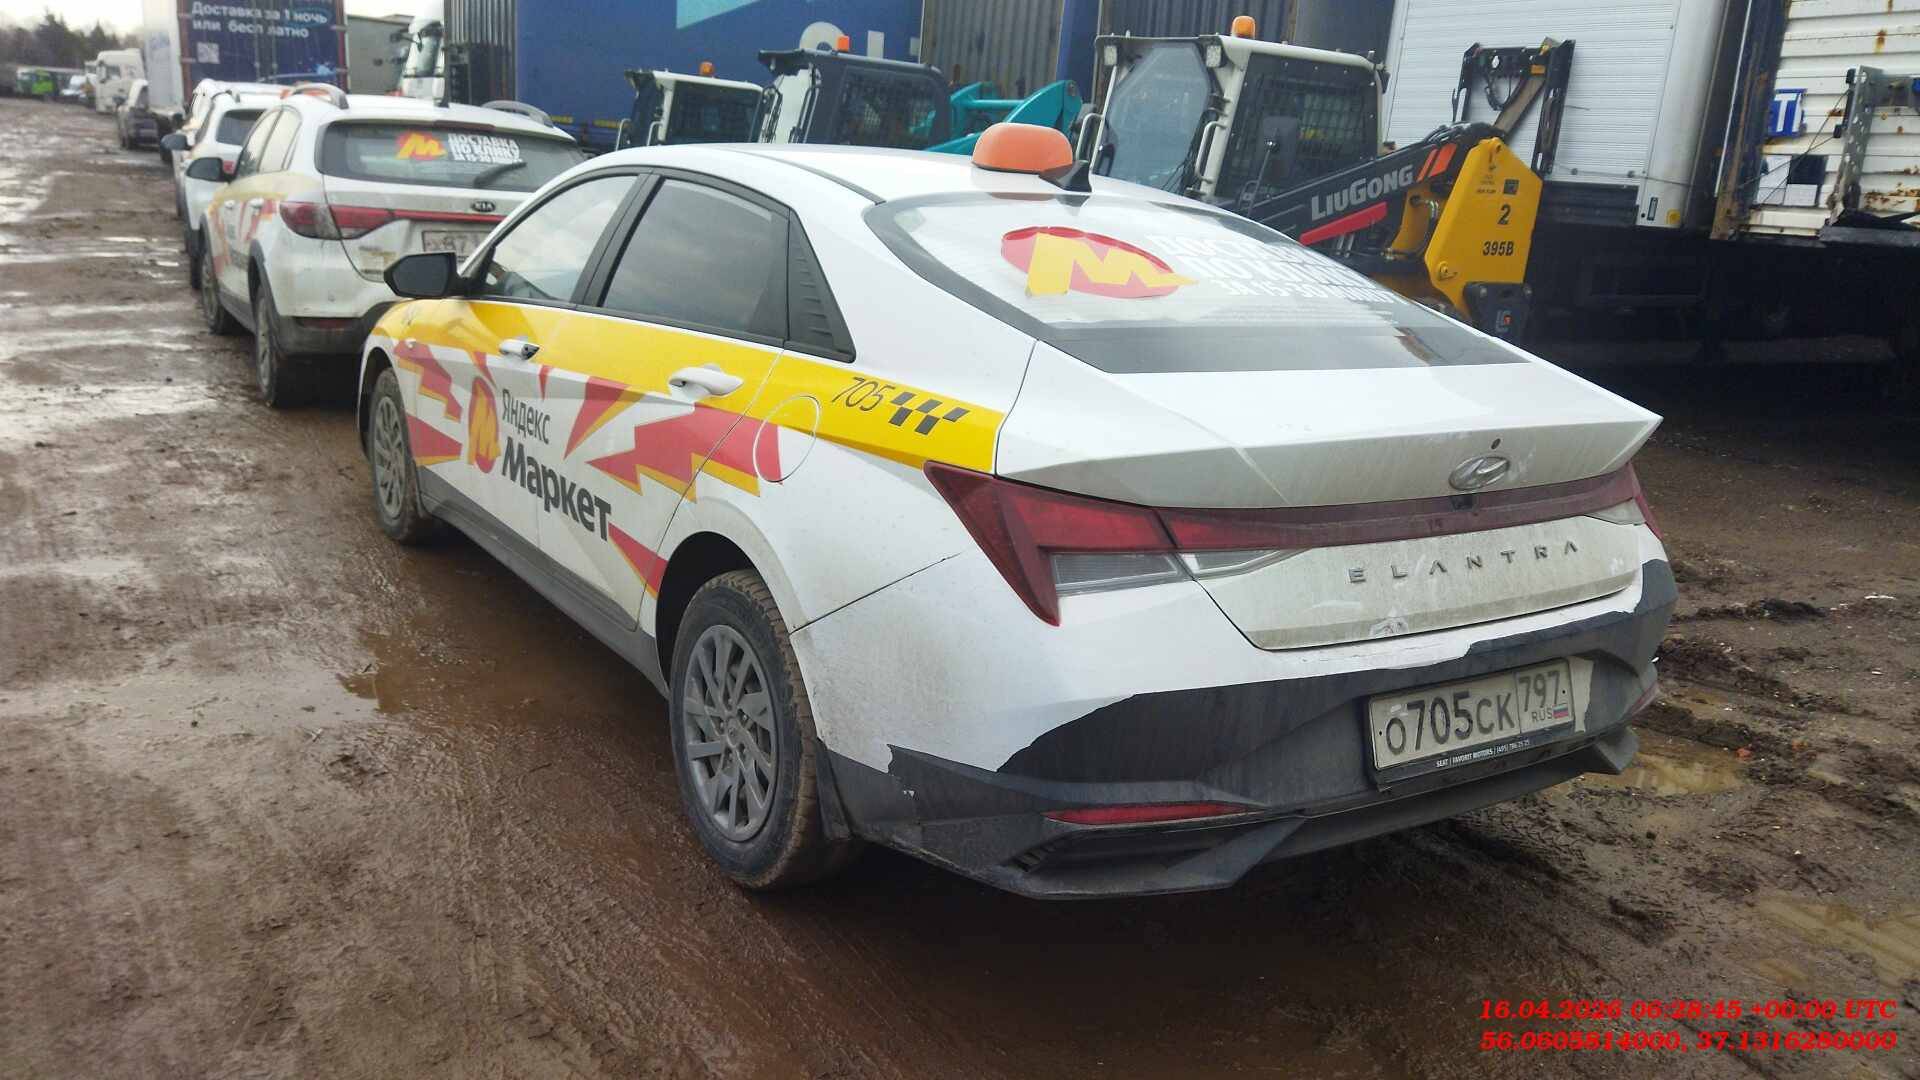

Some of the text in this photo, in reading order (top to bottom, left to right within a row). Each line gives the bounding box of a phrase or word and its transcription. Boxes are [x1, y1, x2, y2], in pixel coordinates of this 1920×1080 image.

[191, 1, 328, 24] Доставка за 1 ночь
[192, 20, 221, 31] или
[1497, 204, 1512, 226] 2
[1482, 240, 1515, 257] 395B
[831, 376, 896, 412] 705
[502, 388, 550, 445] Яндекс
[502, 436, 612, 542] Маркет
[1347, 540, 1578, 584] ELANTRA
[1518, 670, 1562, 713] 797
[1531, 709, 1553, 722] RUS
[1436, 759, 1448, 768] SEAT
